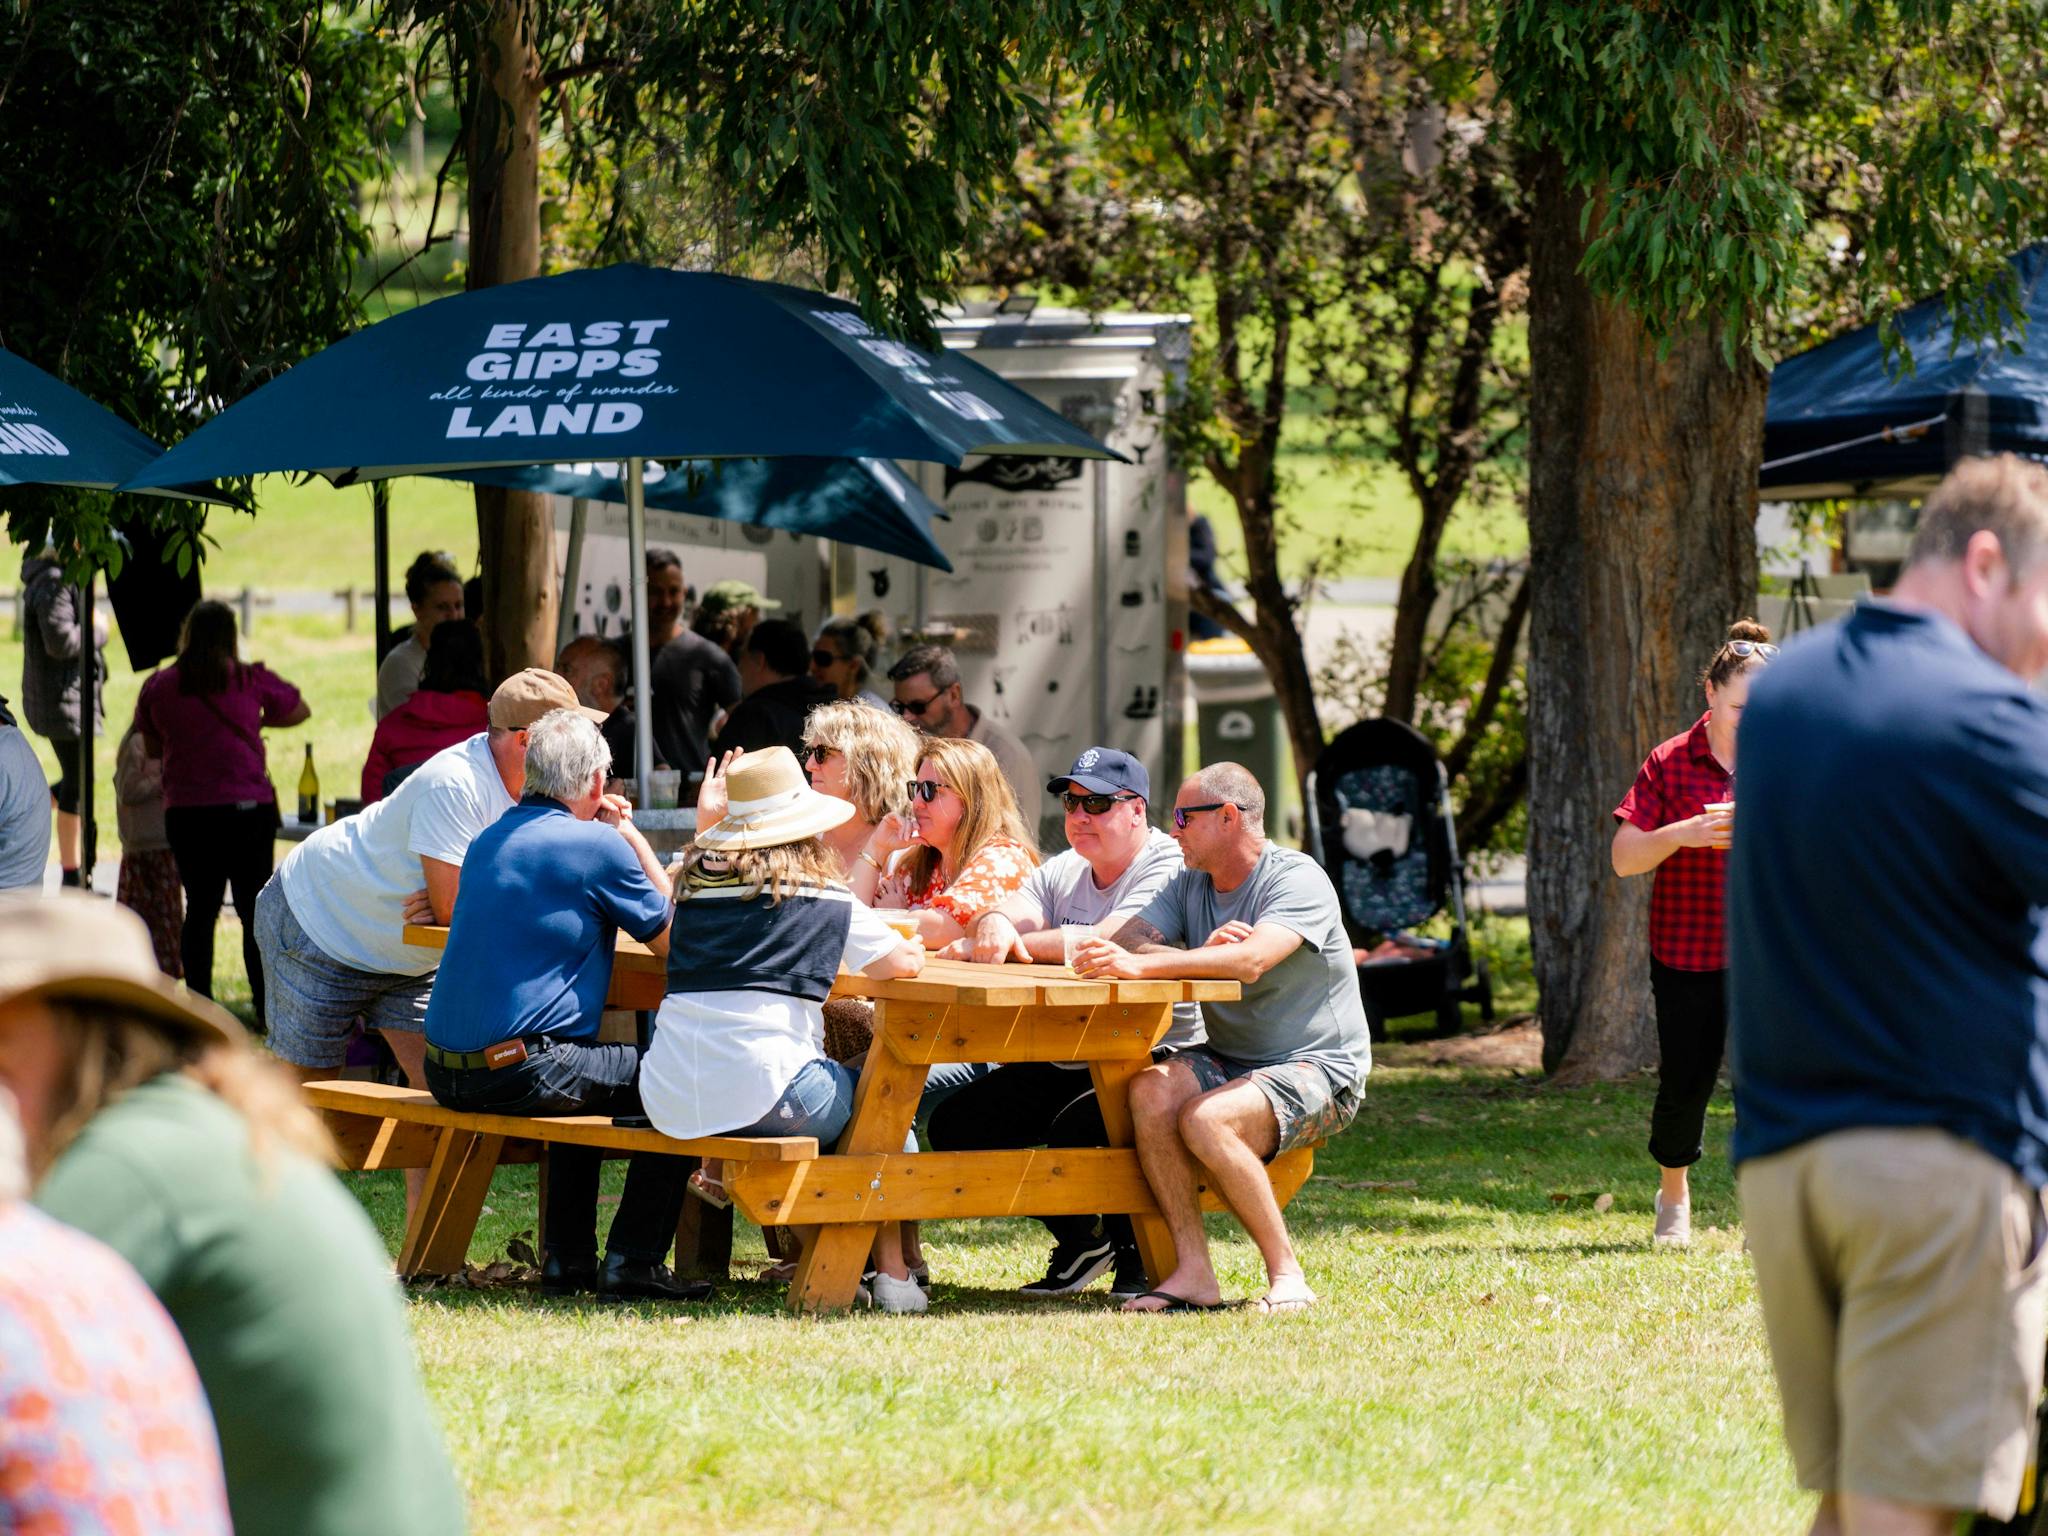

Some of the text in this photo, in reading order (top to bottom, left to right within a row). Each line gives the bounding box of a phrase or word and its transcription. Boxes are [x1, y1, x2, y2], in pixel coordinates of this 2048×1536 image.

[484, 319, 670, 349] EAST
[465, 348, 662, 381] GIPPS
[429, 381, 679, 403] all kinds of wonder
[445, 402, 644, 438] LAND
